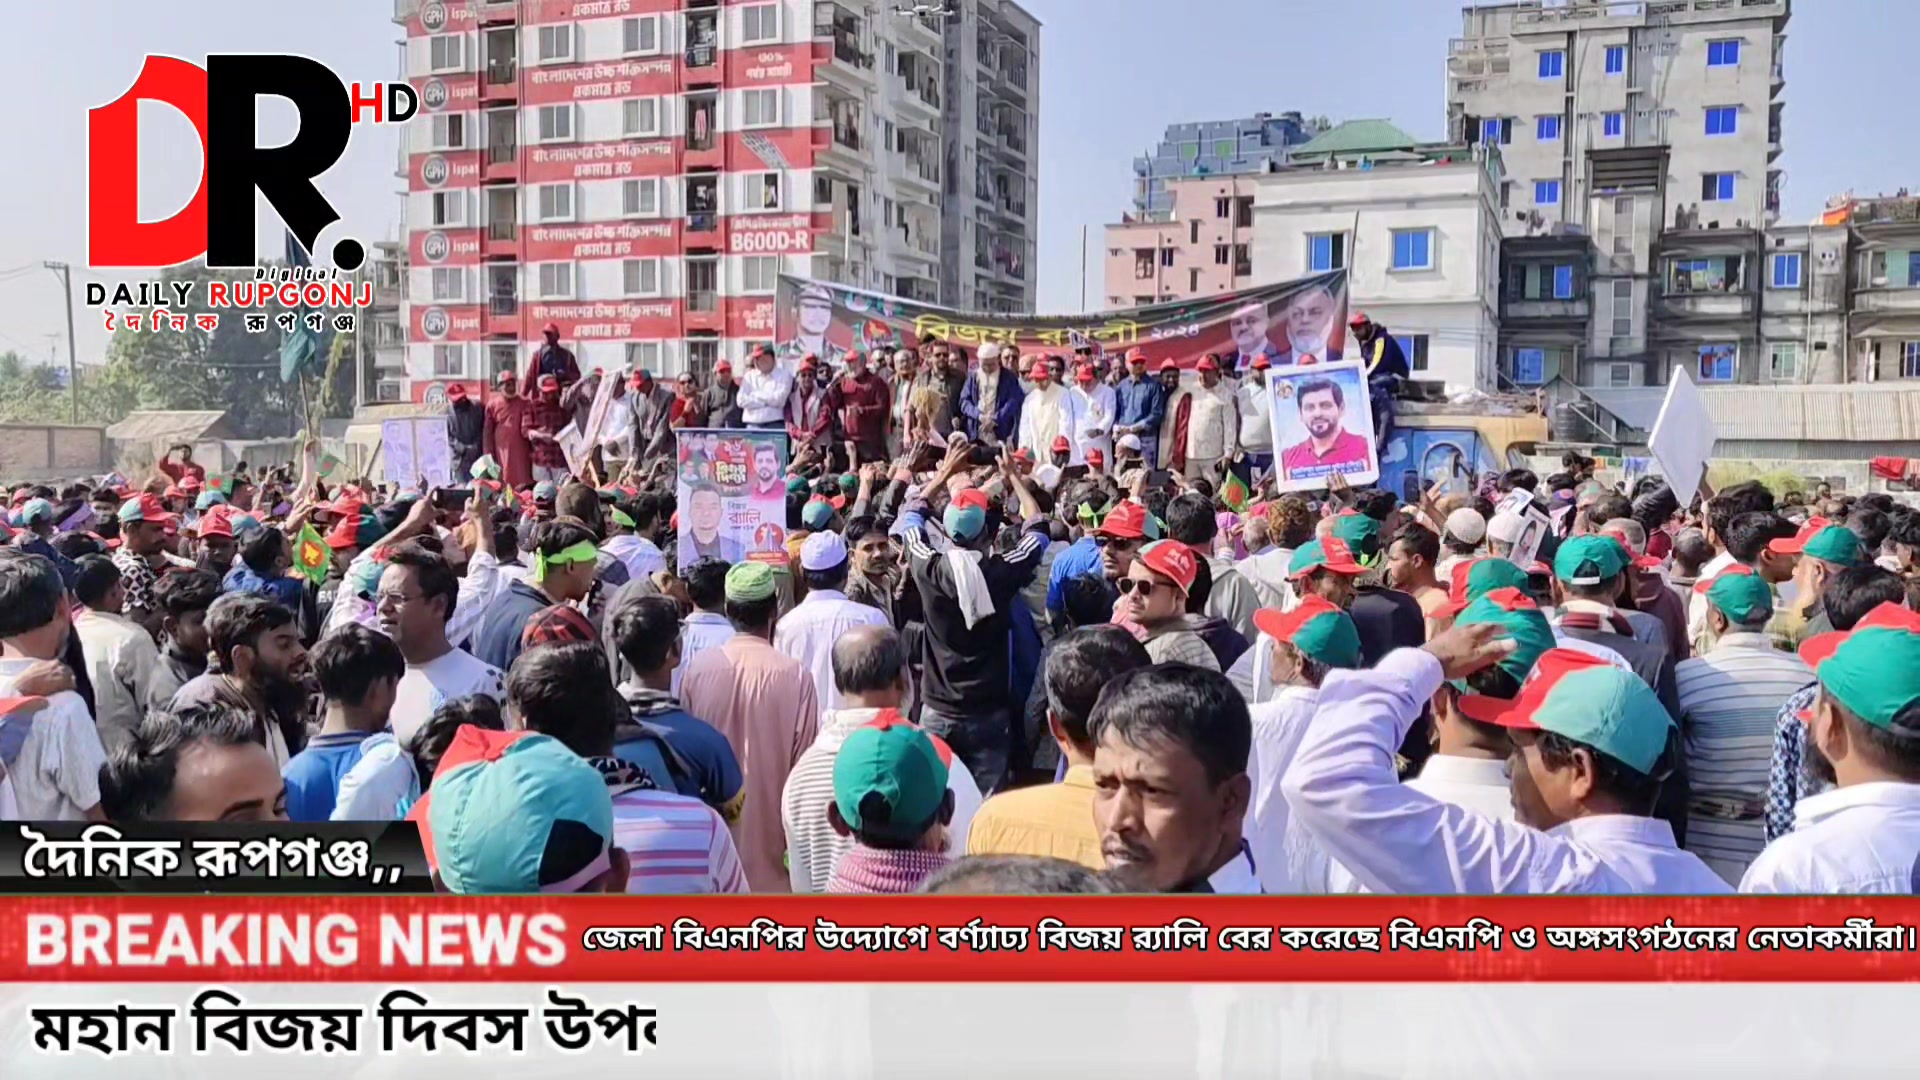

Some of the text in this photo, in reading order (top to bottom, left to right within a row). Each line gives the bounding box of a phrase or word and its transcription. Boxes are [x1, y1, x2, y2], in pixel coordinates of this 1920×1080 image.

[424, 11, 444, 24] GPH
[425, 90, 445, 103] GPH
[425, 166, 445, 179] GPH
[426, 240, 445, 254] GPH
[731, 230, 809, 252] B600D-R
[426, 318, 445, 332] GPH
[1151, 323, 1200, 340] ২০২৪
